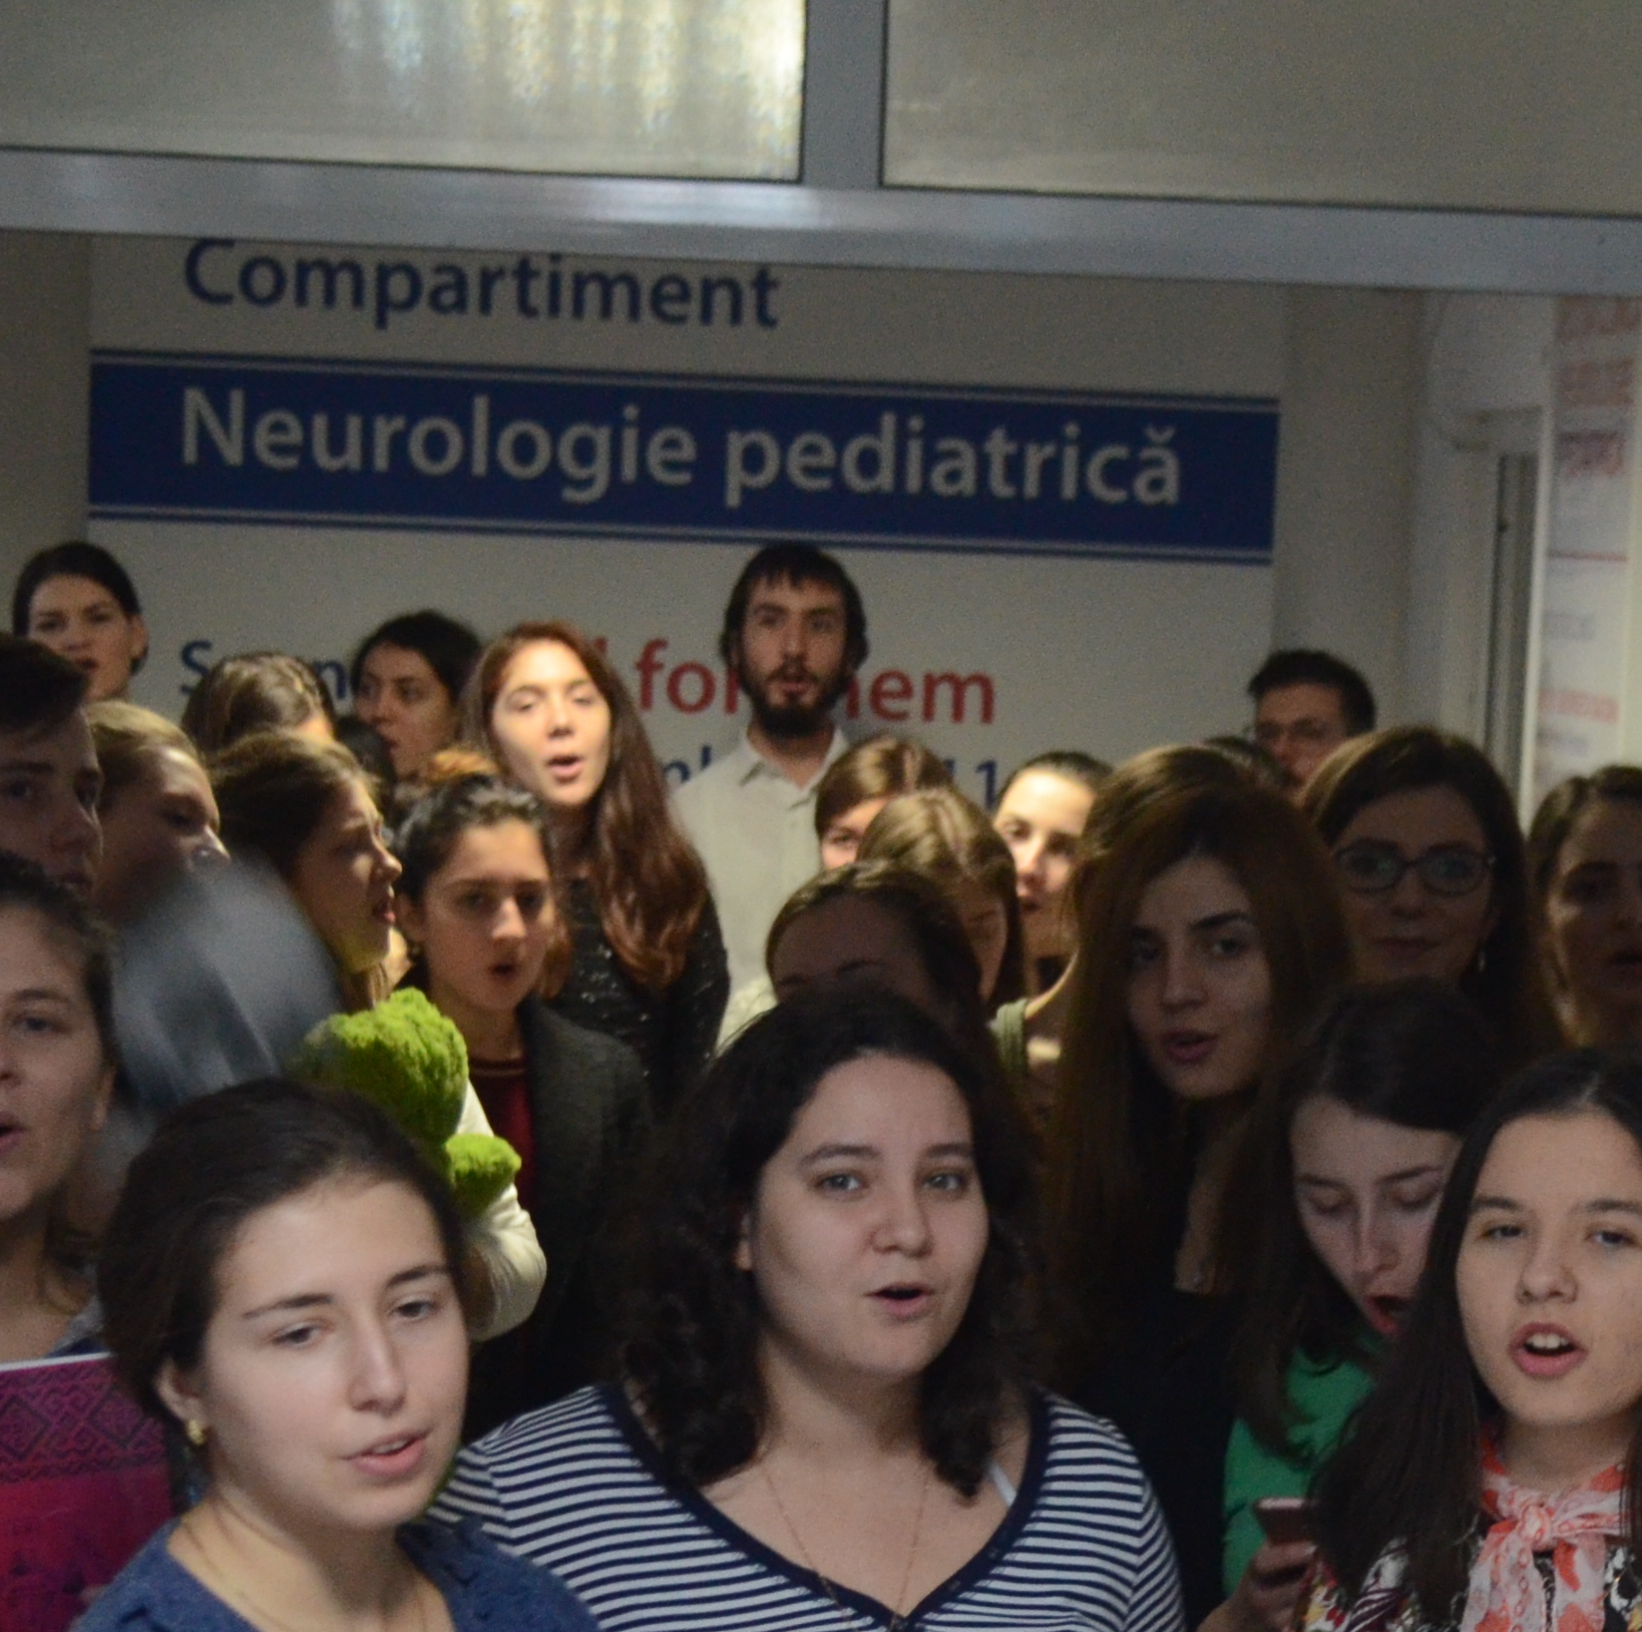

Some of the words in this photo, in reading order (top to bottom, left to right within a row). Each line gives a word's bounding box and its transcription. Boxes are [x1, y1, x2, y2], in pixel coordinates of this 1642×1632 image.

[183, 238, 780, 331] Compartiment
[180, 385, 697, 503] Neurologie
[724, 409, 1182, 511] pediatrică
